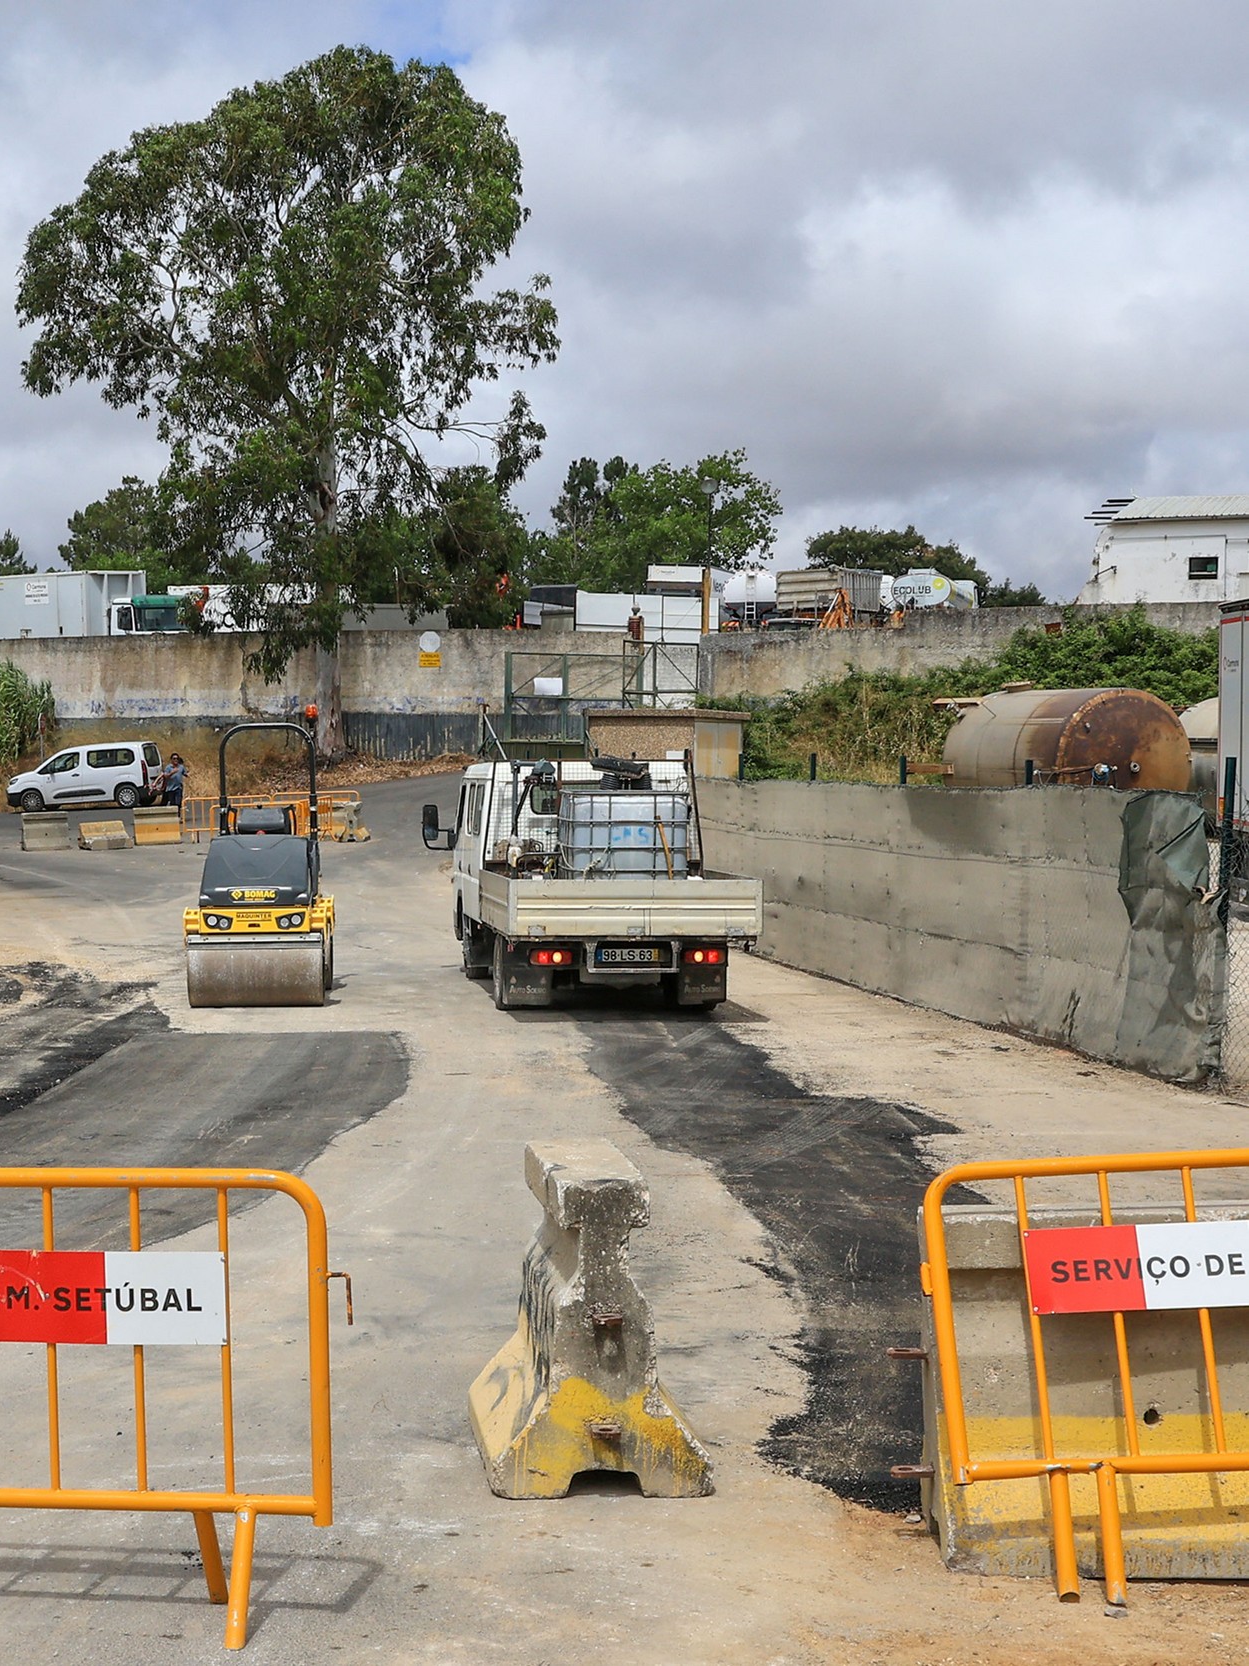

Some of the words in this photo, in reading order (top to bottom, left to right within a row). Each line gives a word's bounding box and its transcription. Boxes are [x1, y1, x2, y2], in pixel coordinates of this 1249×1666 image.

[893, 585, 932, 595] ECOLUB
[244, 890, 276, 899] BOMAG
[1051, 1255, 1191, 1286] SERVIÇO
[1204, 1253, 1246, 1277] DE
[6, 1285, 40, 1311] M.
[53, 1281, 203, 1313] SETÚBAL
